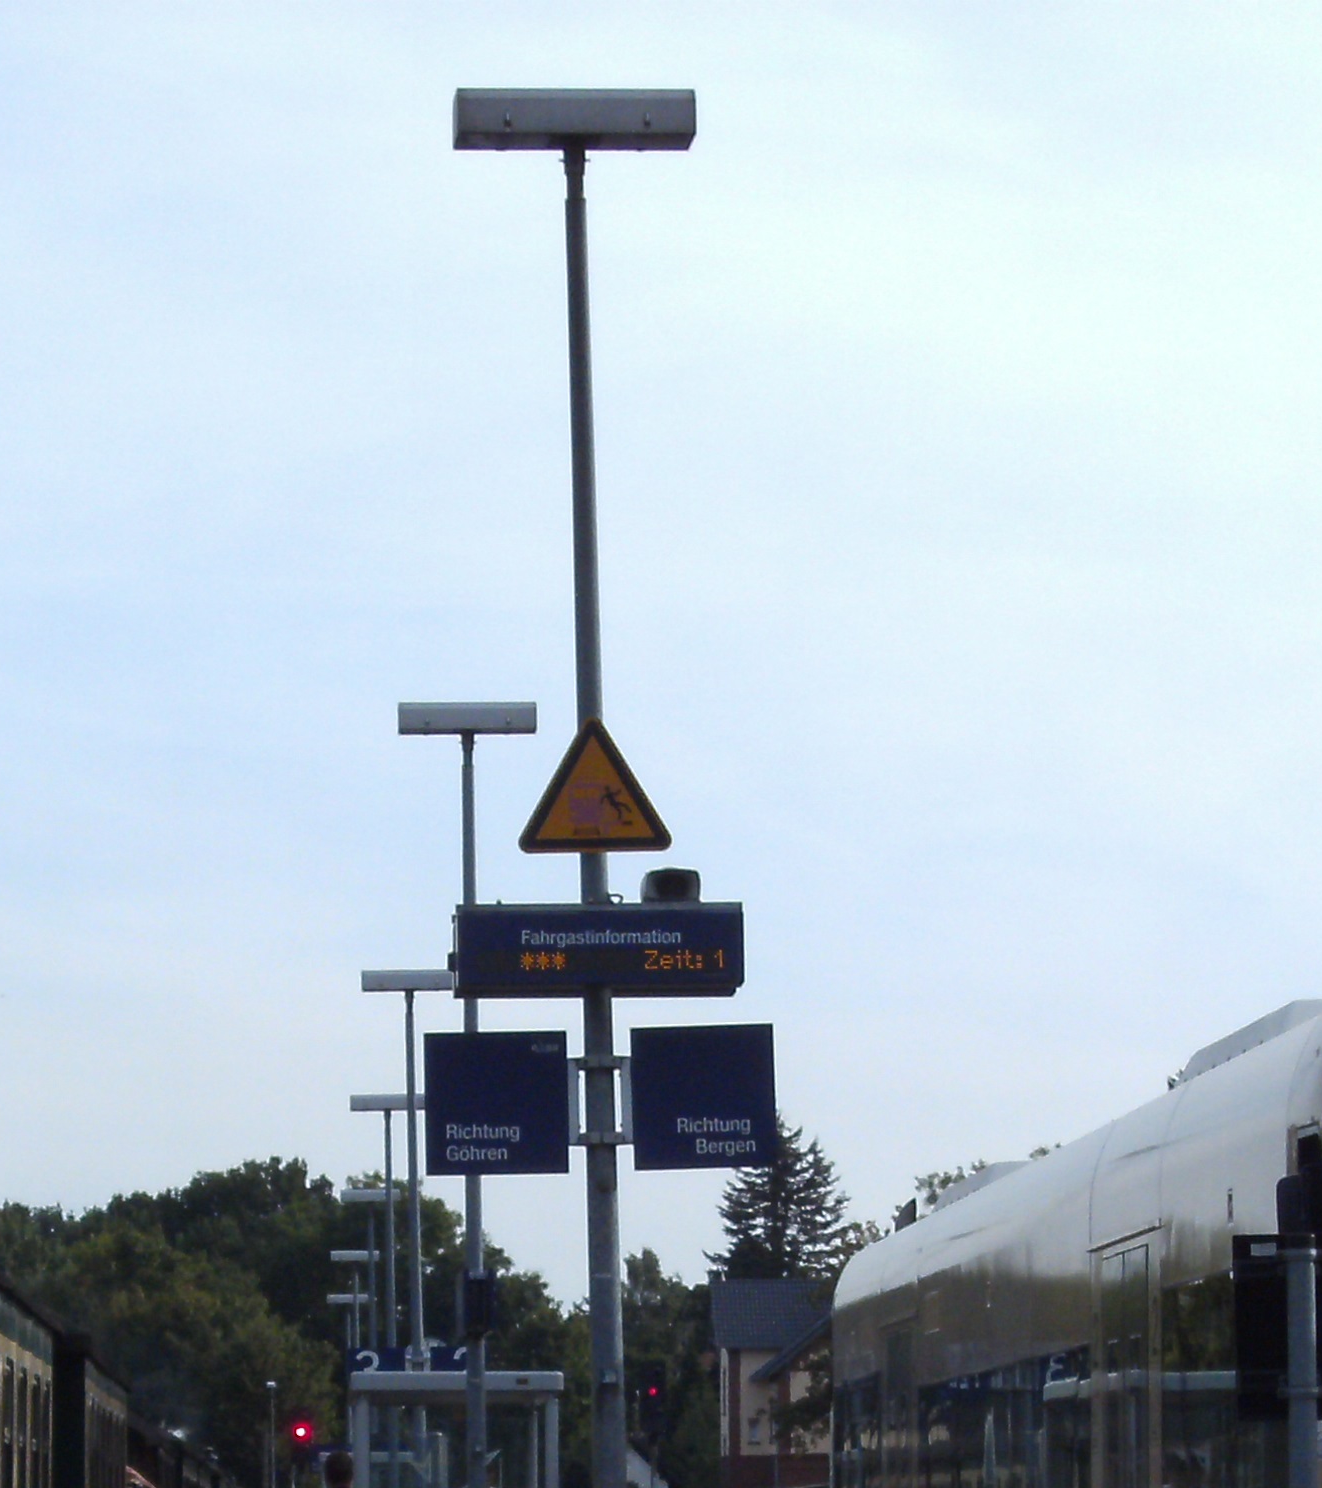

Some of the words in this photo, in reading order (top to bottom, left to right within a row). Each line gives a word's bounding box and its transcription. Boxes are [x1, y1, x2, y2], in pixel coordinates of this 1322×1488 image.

[520, 929, 682, 948] Fahrgastinformation
[643, 949, 702, 970] Zeit:
[445, 1123, 521, 1143] Richtung
[677, 1116, 752, 1136] Richtung
[445, 1144, 508, 1162] Göhren
[695, 1138, 757, 1156] Bergen
